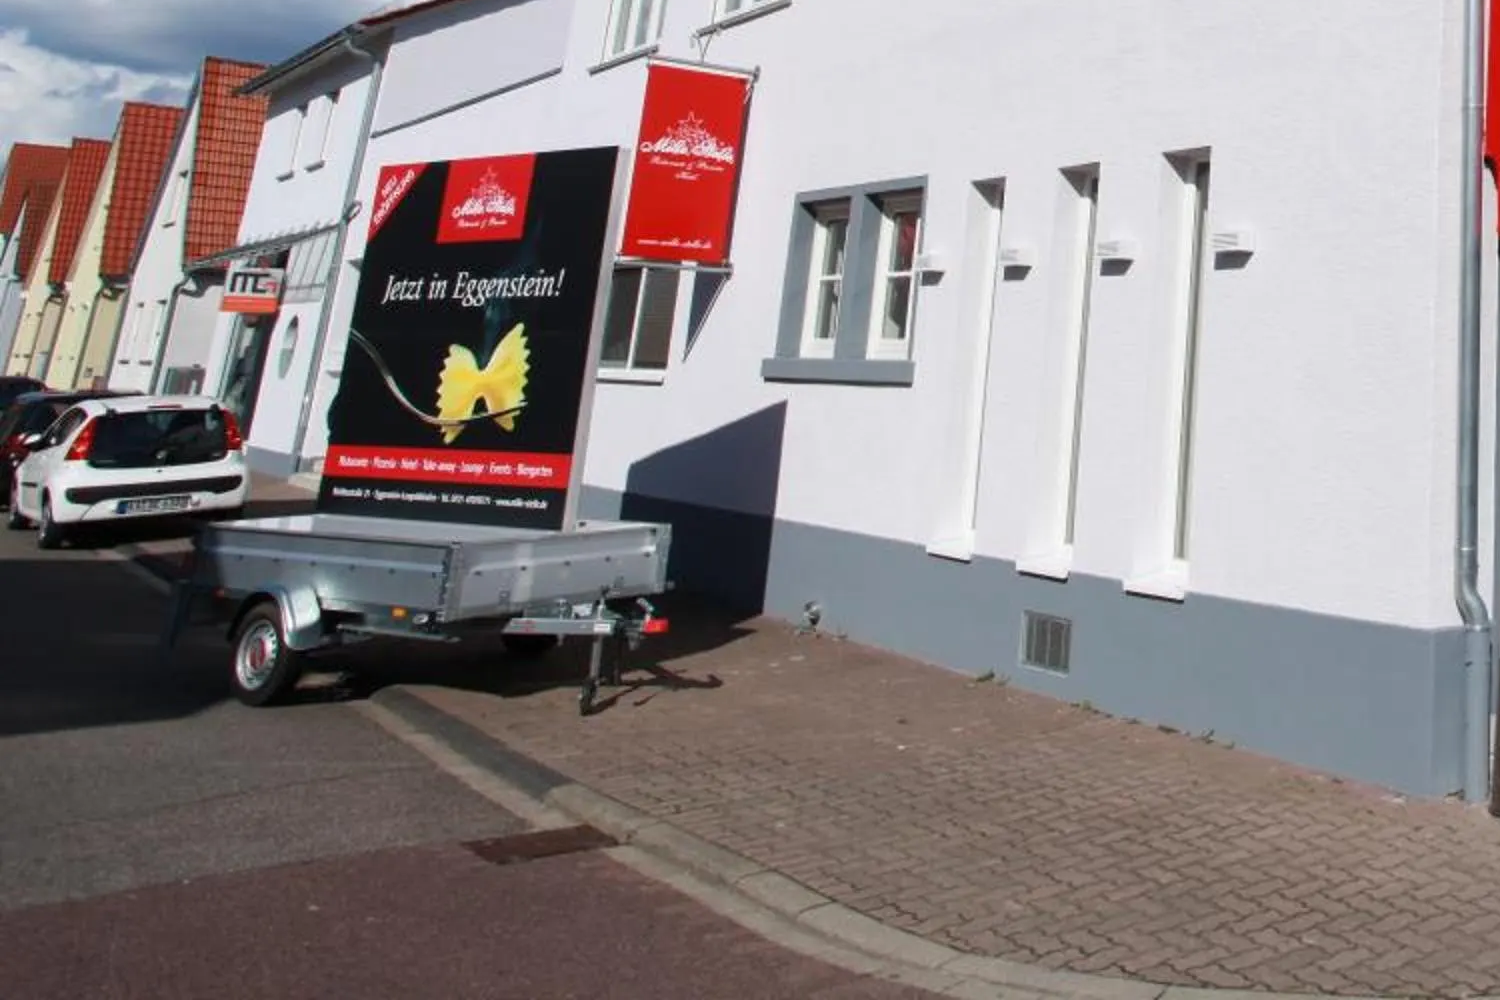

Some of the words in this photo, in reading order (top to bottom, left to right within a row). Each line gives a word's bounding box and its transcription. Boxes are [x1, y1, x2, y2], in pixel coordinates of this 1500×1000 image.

[381, 274, 424, 305] Jetzt
[428, 272, 448, 299] in
[452, 267, 566, 307] Eggenstein!
